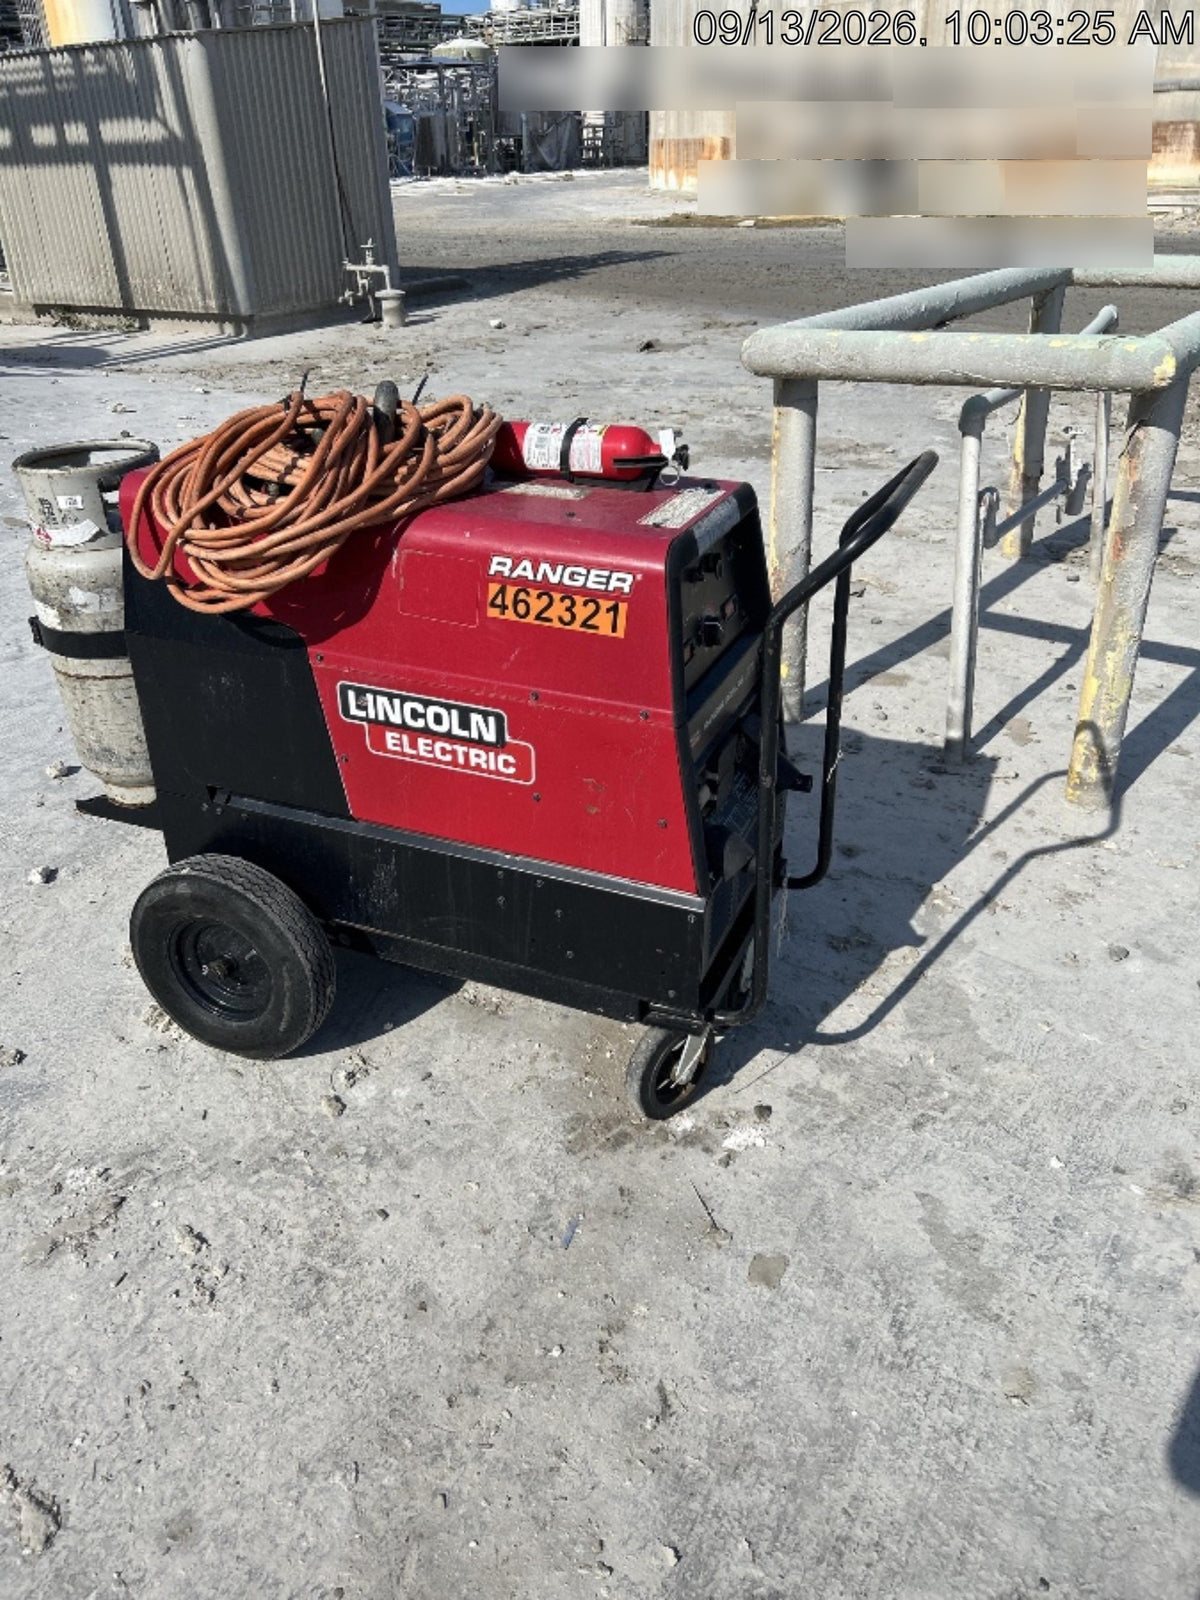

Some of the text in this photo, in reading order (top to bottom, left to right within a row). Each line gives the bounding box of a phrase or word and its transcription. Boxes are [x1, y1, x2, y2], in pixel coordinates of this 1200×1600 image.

[487, 554, 634, 595] RANGER
[488, 584, 620, 633] 462321
[347, 688, 497, 744] LINCOLN
[384, 730, 517, 775] ELECTRIC
